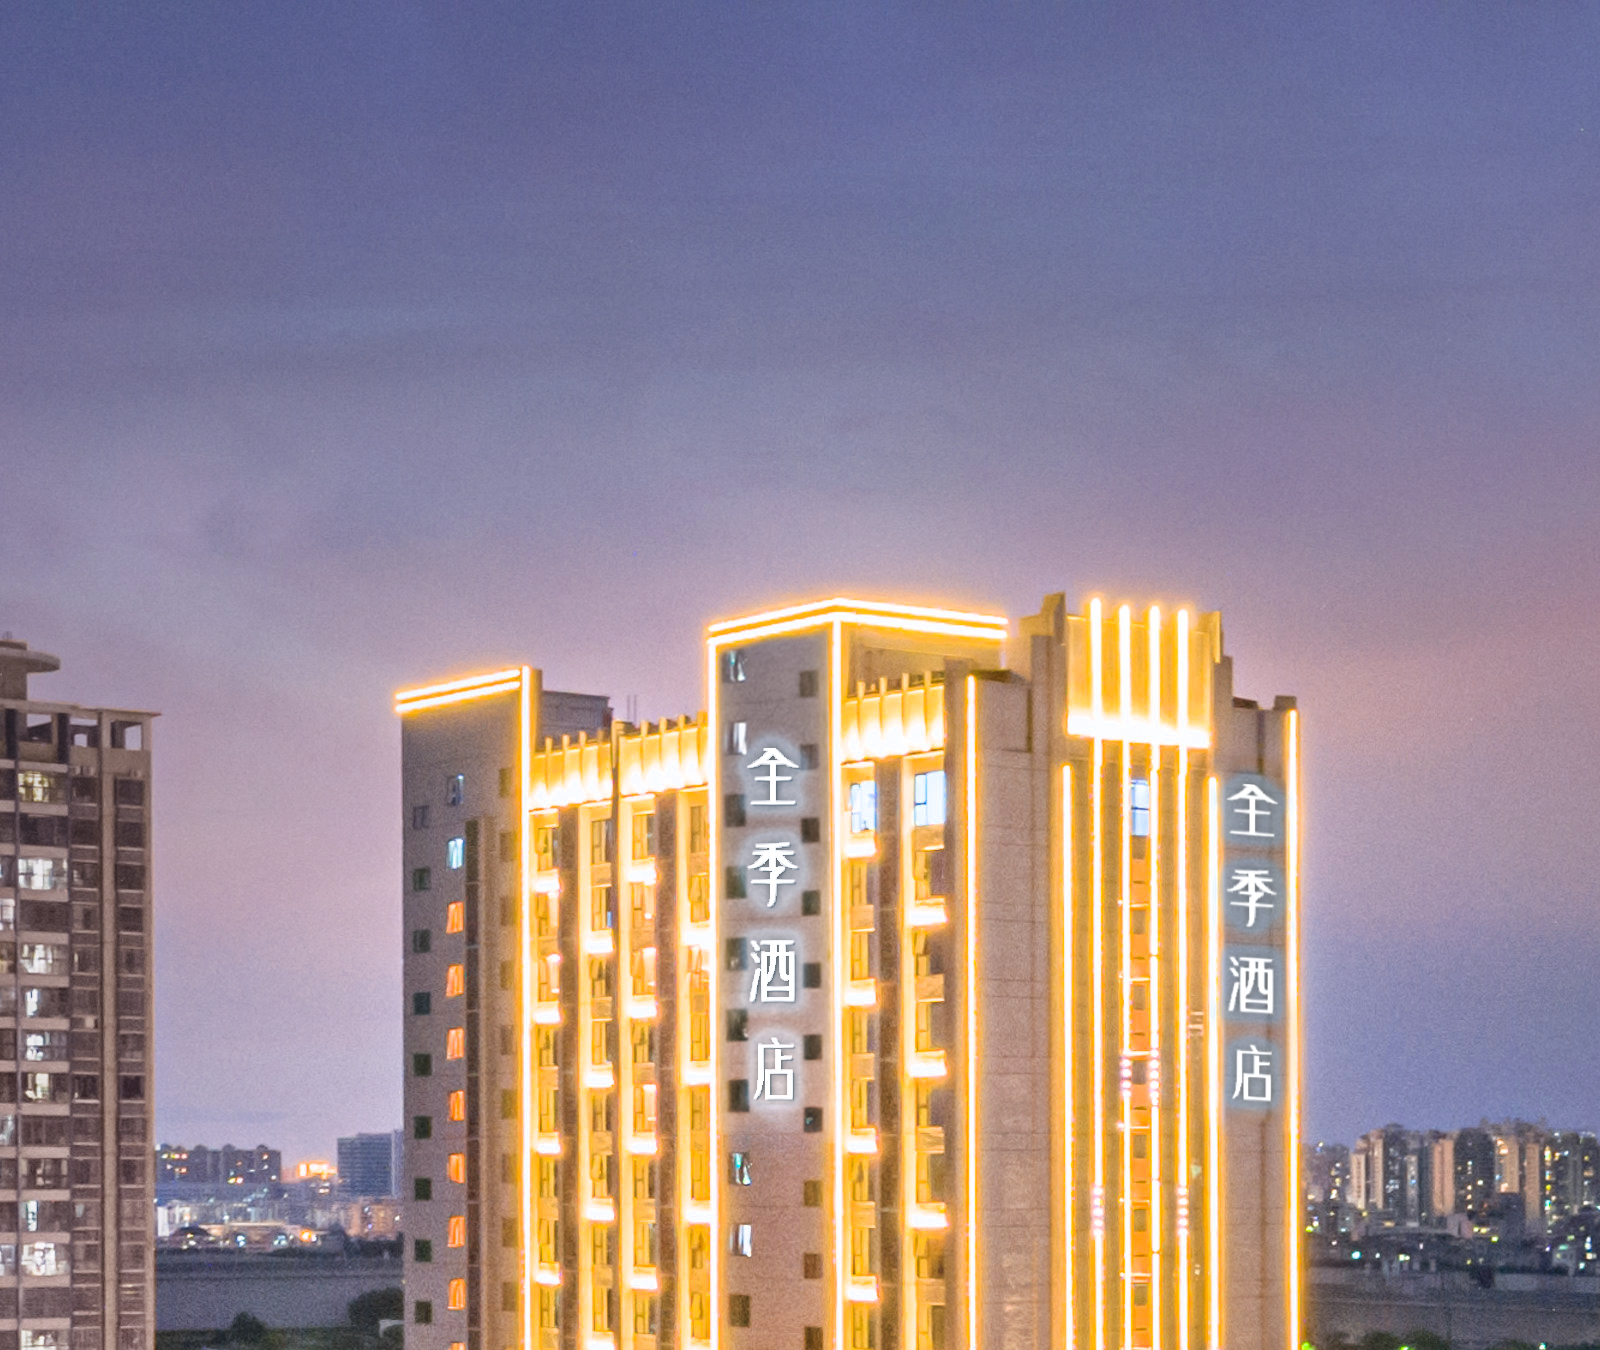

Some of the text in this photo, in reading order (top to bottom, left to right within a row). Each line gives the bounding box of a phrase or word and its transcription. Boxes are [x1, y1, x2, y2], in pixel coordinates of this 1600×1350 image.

[746, 747, 799, 1102] 全季酒店
[1227, 783, 1278, 1102] 全季酒店
